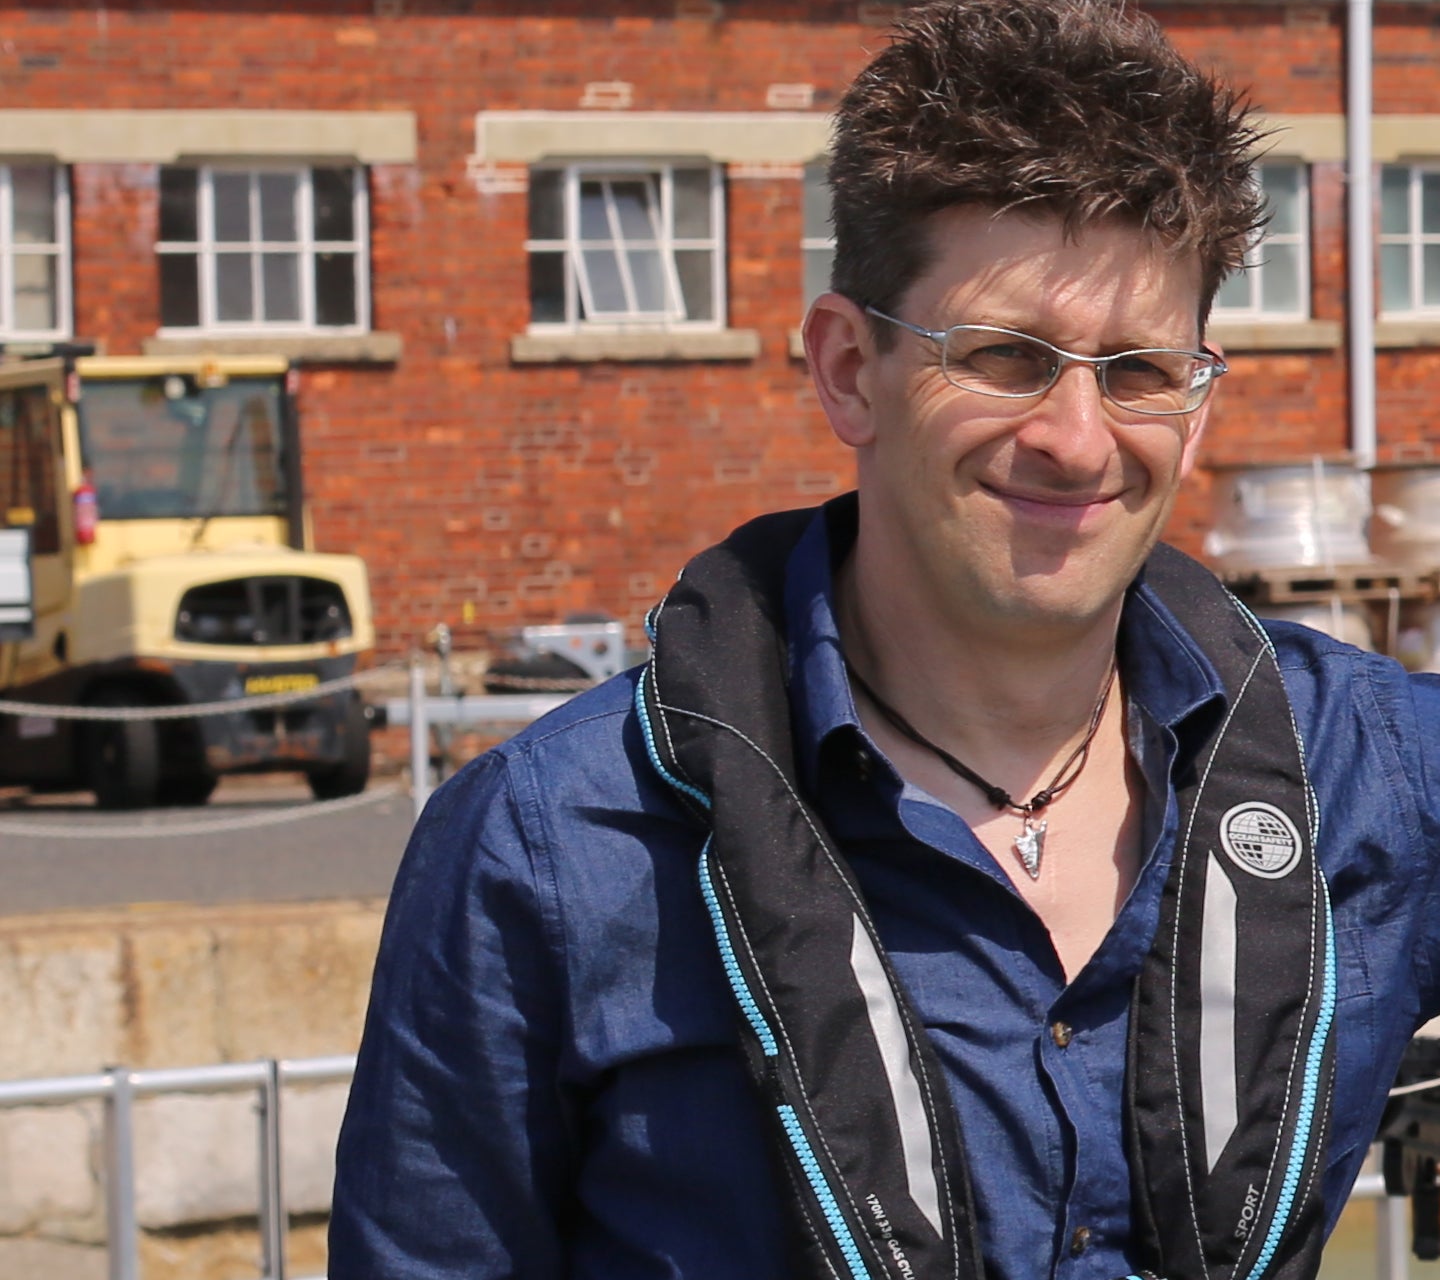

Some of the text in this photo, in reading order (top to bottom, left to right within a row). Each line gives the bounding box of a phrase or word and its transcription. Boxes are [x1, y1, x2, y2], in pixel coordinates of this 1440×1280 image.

[1229, 833, 1293, 846] OCEAN SAFETY
[865, 1193, 886, 1219] 170N
[887, 1239, 905, 1261] GAS
[1234, 1183, 1261, 1241] SPORT
